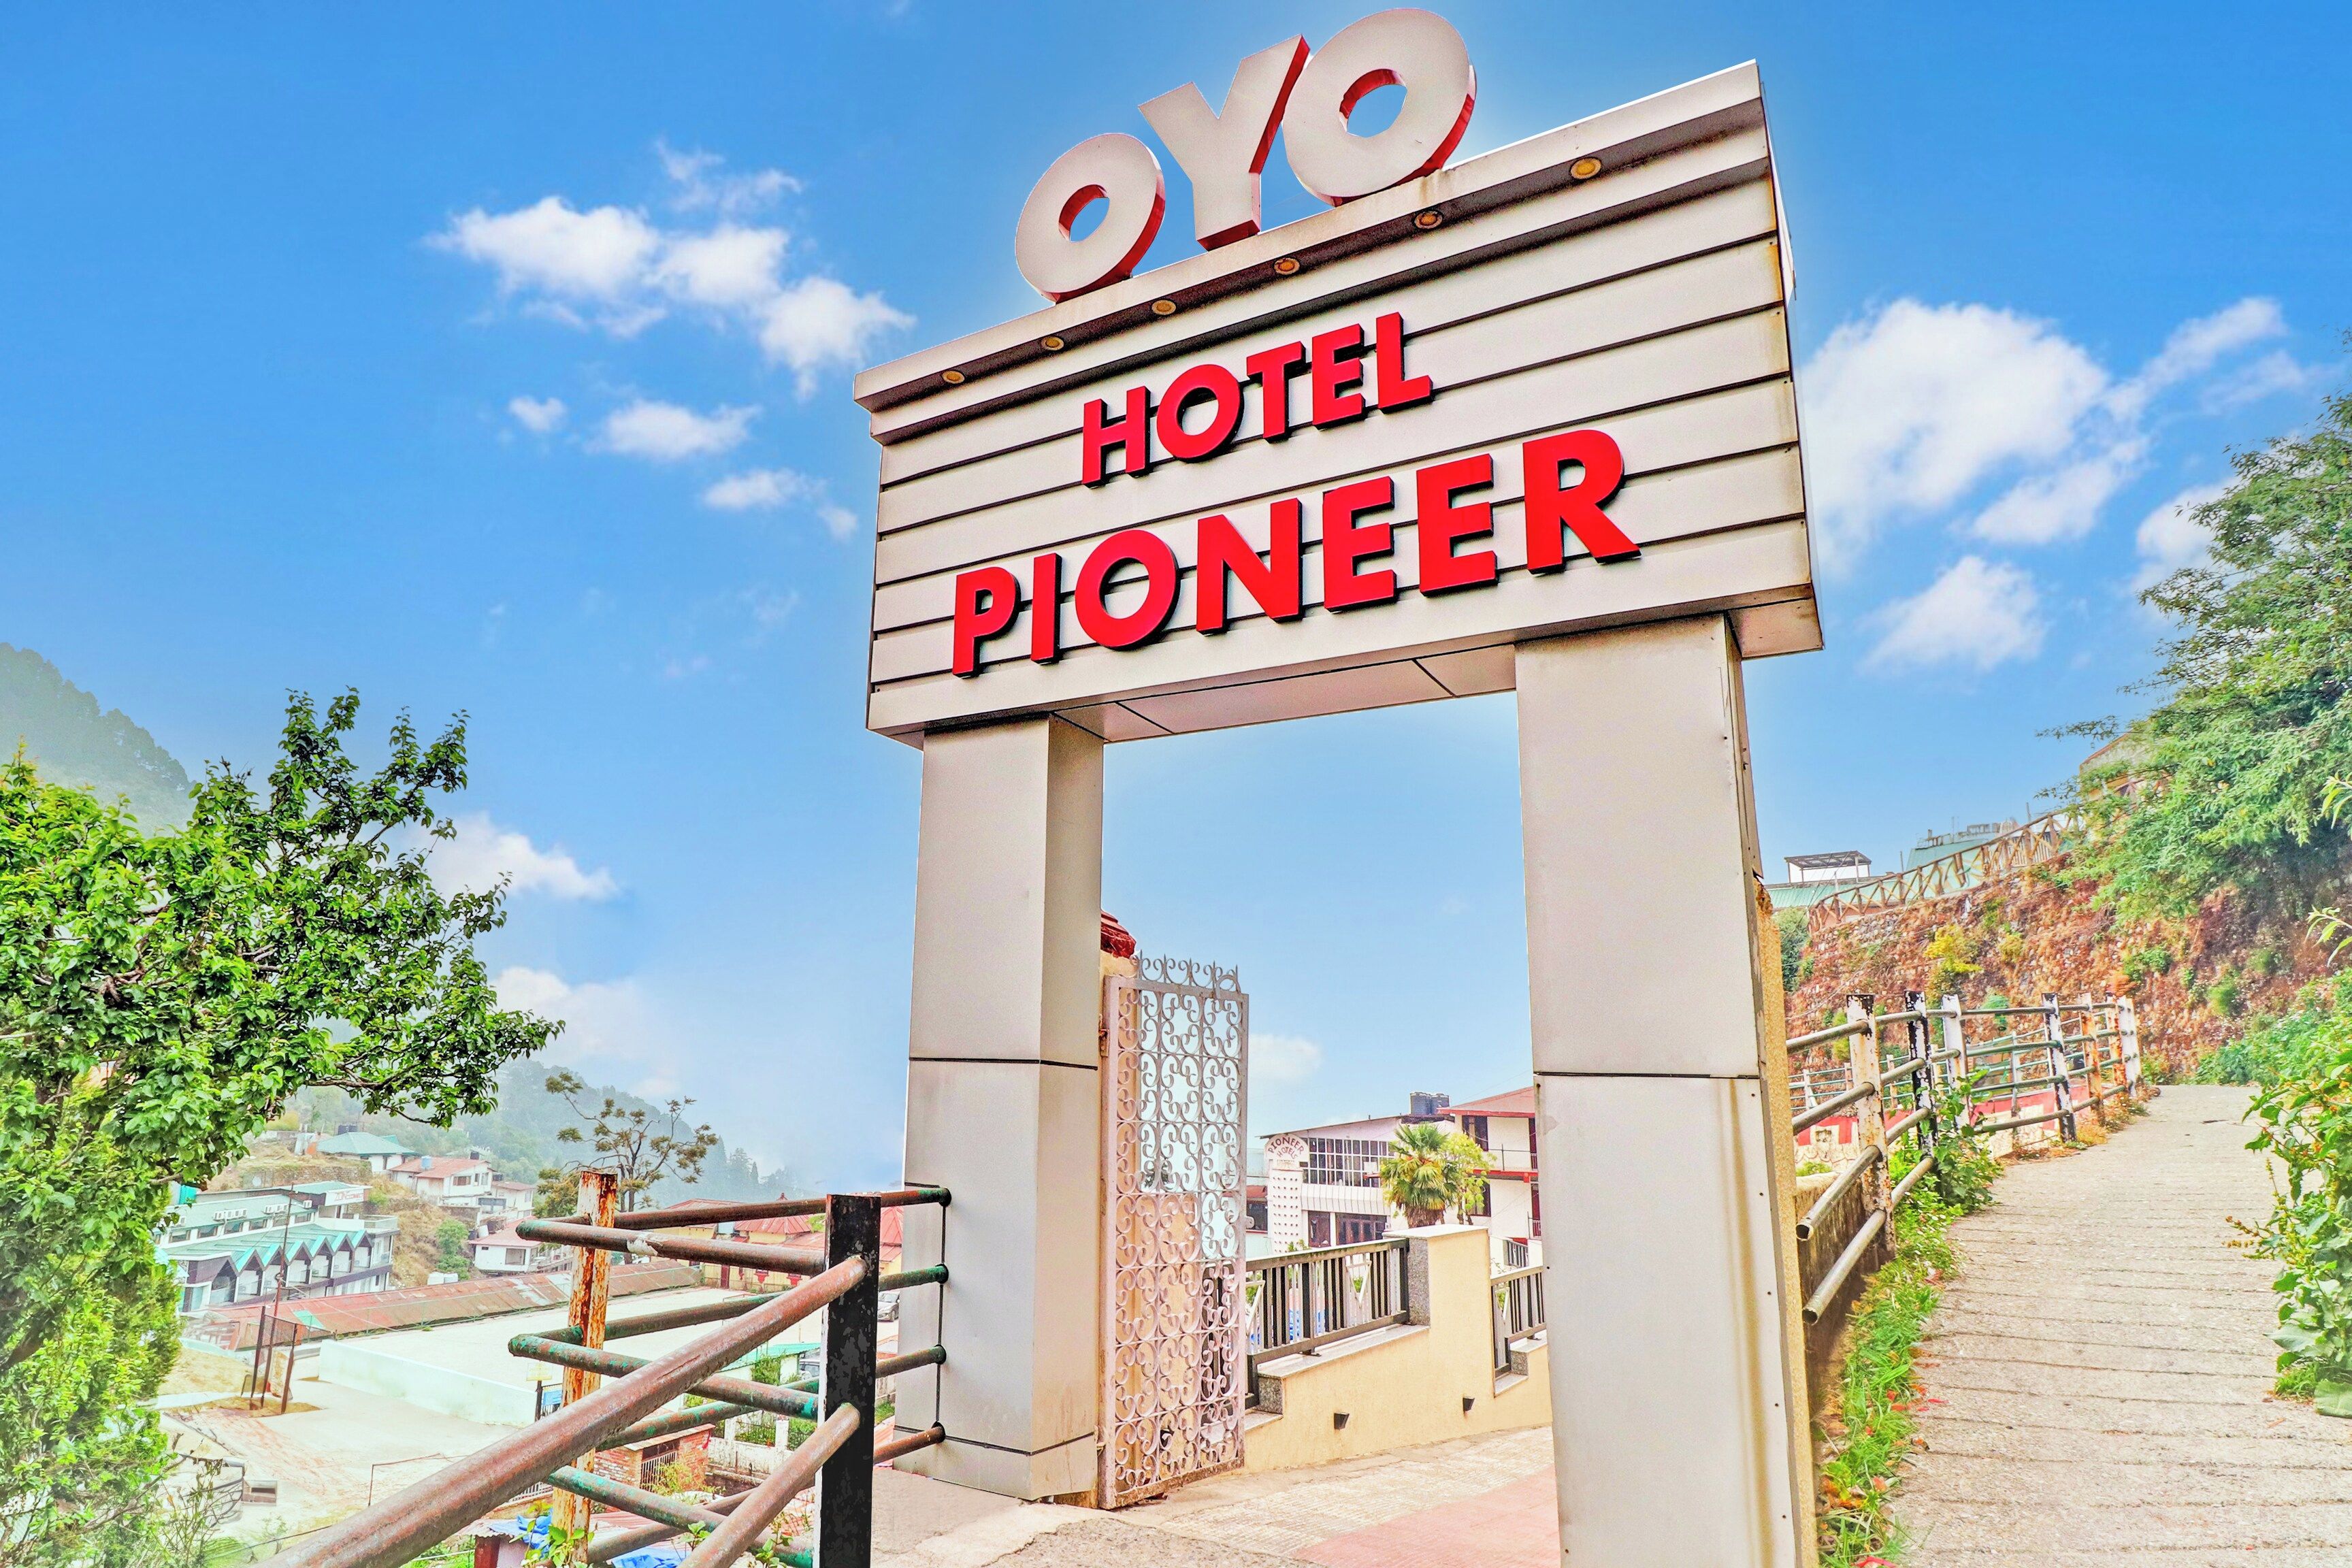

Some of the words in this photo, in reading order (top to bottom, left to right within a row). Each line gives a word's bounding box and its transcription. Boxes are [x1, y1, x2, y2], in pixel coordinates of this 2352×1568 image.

[1015, 8, 1477, 304] OYO
[1081, 312, 1434, 487] HOTEL
[951, 429, 1641, 678] PIONEER
[1268, 1137, 1305, 1155] PIONEER
